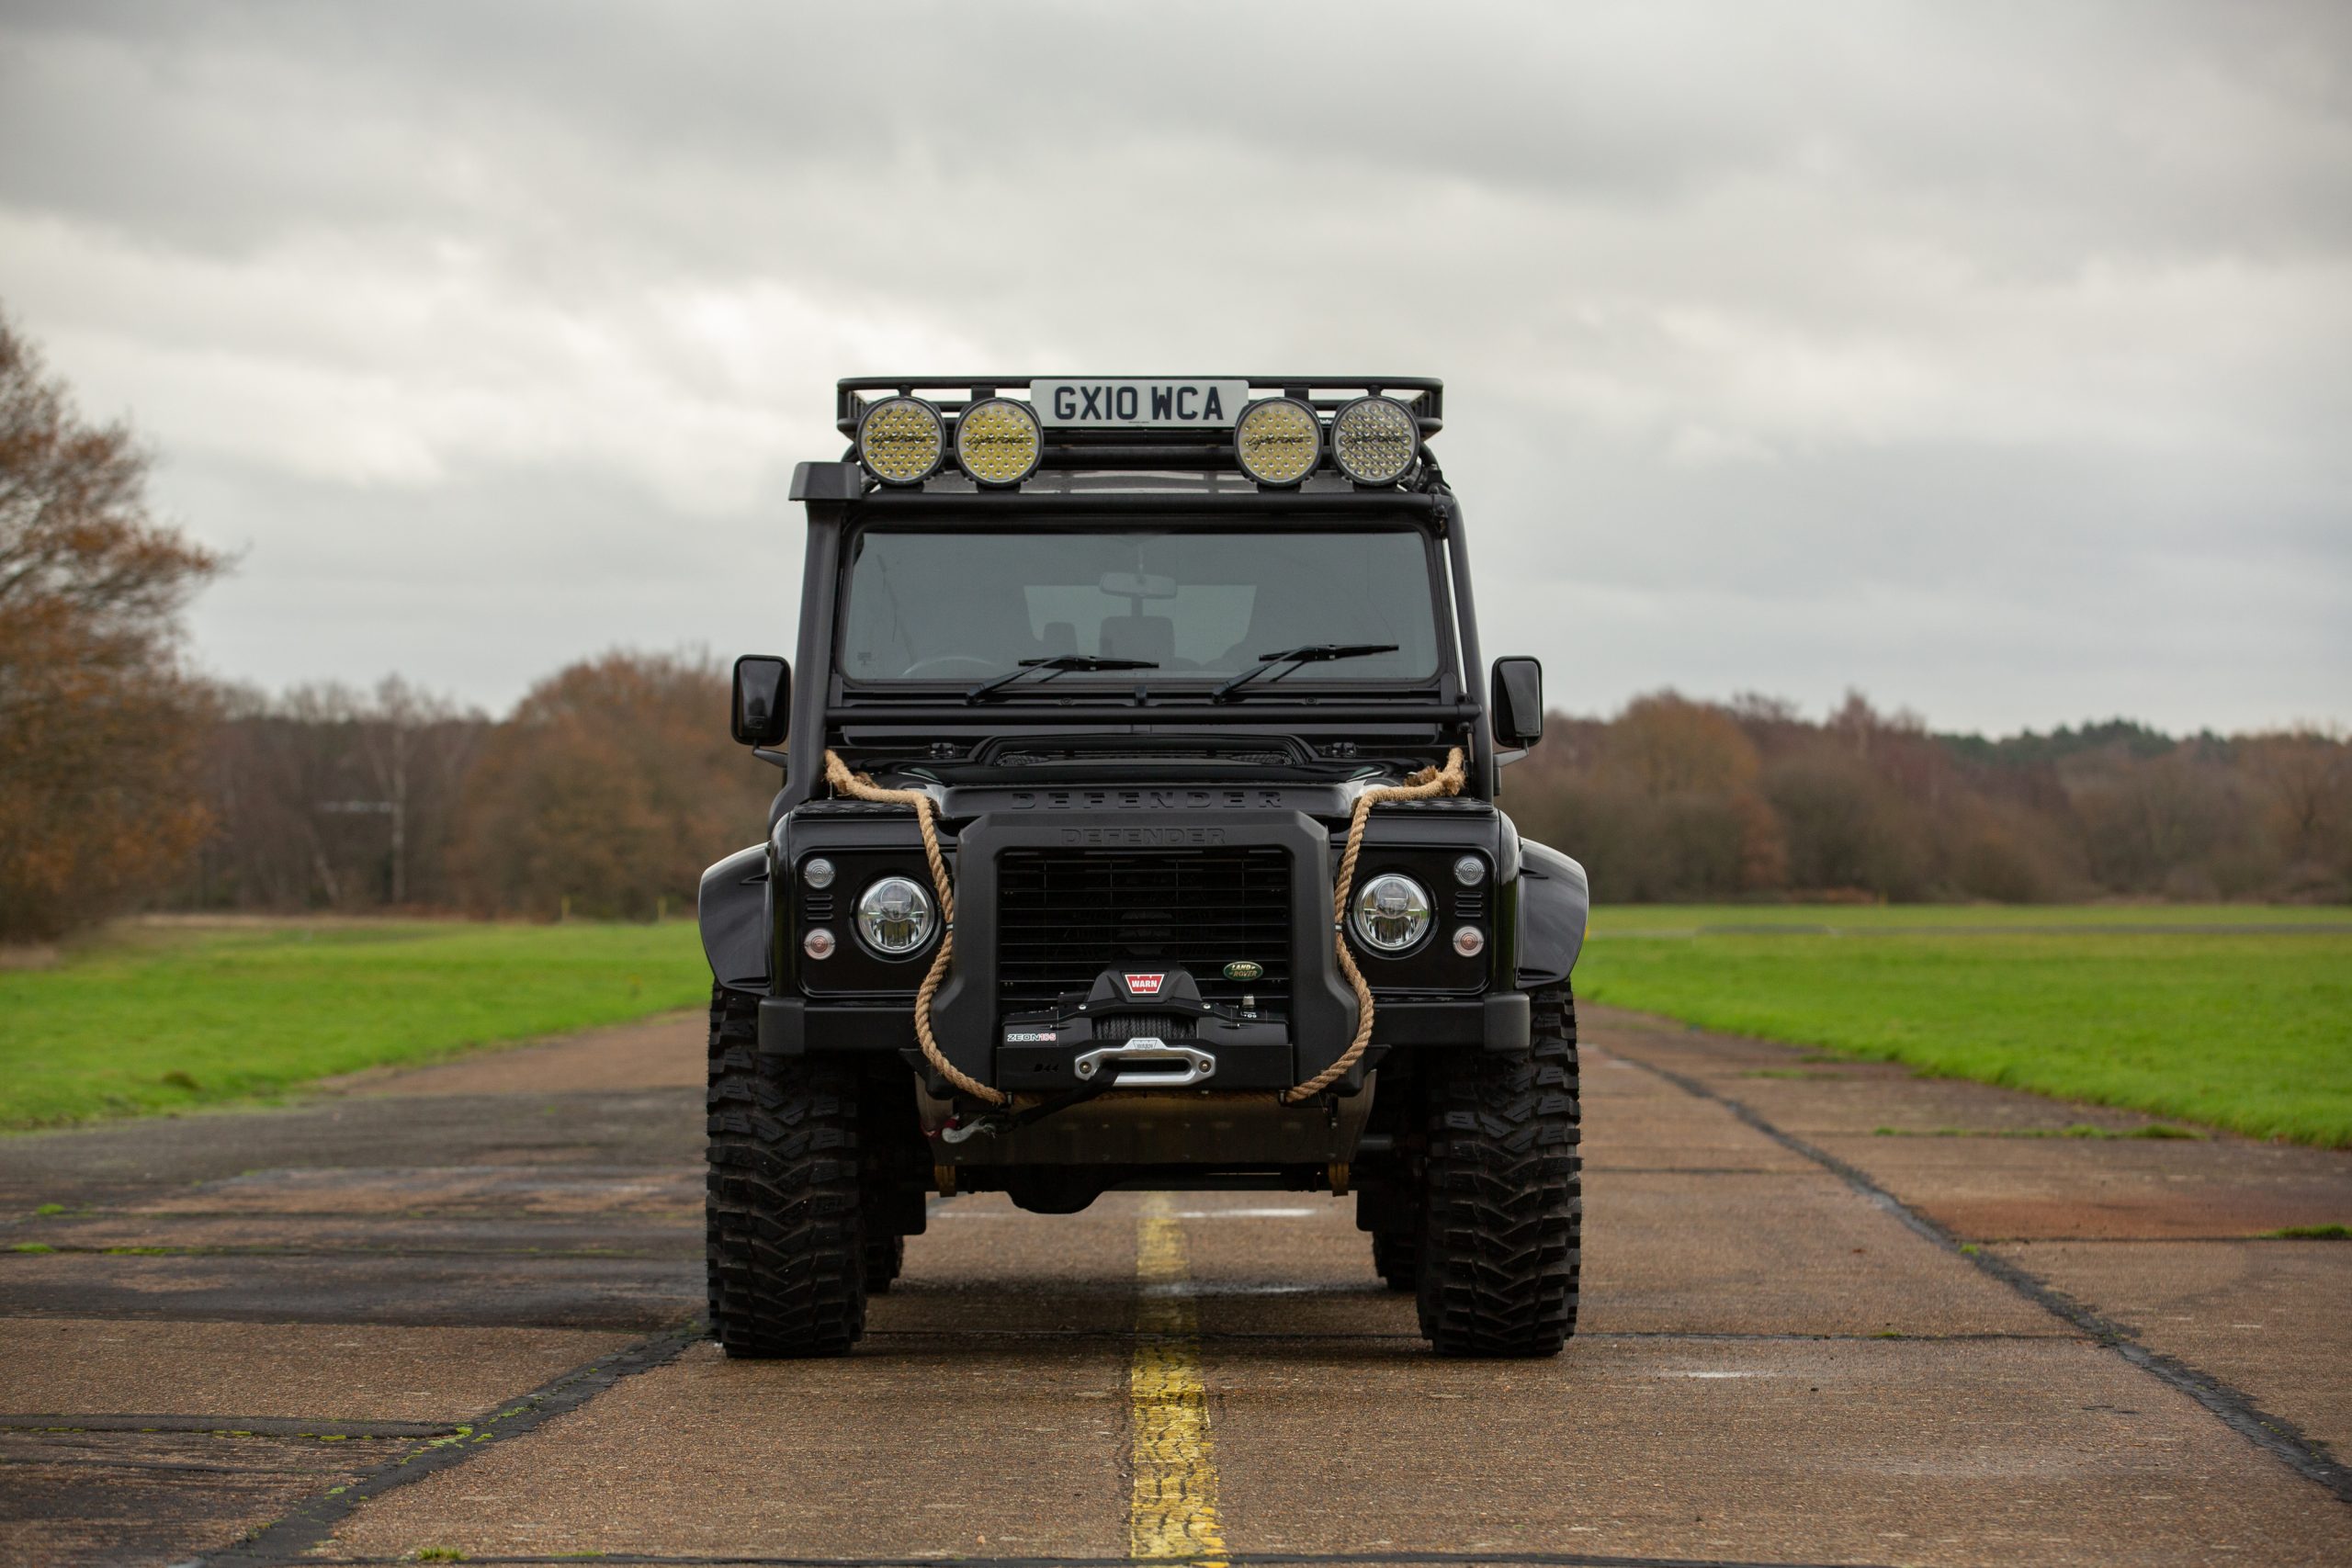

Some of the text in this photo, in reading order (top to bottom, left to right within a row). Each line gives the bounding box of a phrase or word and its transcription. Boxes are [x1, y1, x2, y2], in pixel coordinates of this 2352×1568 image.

[1054, 386, 1224, 421] GX10 WCA
[1012, 791, 1282, 809] DEFENDER
[1061, 828, 1227, 846] DEFENDER
[1131, 979, 1158, 988] WARN
